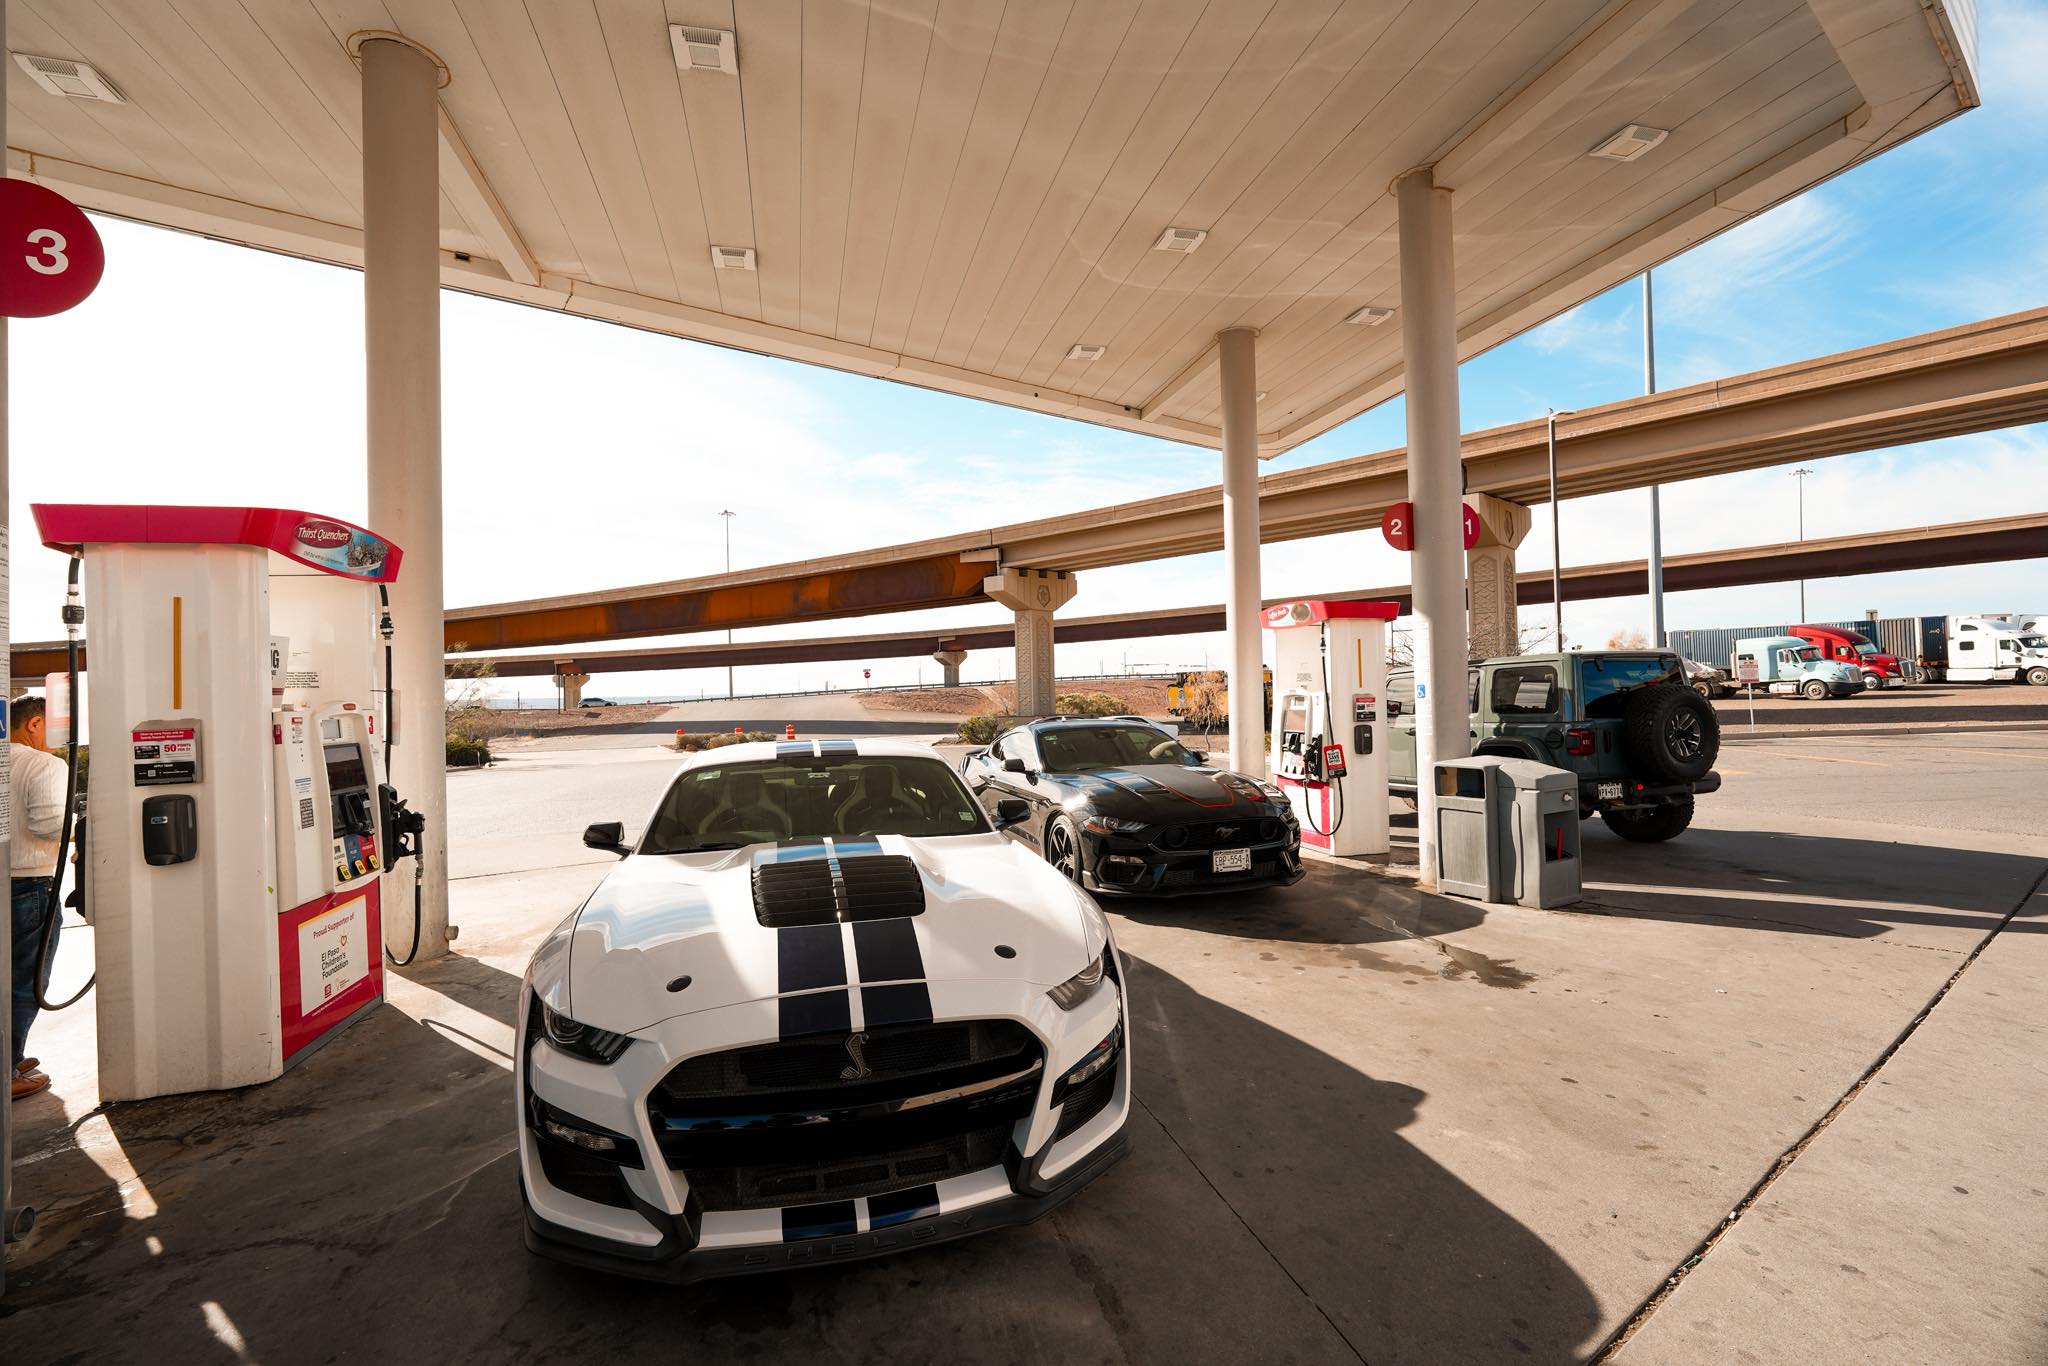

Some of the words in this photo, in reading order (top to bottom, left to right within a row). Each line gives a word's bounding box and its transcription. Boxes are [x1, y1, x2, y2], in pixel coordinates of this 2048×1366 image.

[25, 228, 69, 275] 3
[298, 527, 318, 539] Thirst
[317, 529, 350, 542] Quenchers
[1390, 518, 1403, 535] 2
[1465, 518, 1472, 535] 1
[368, 715, 374, 734] 3
[164, 744, 177, 752] 50
[313, 926, 328, 939] Proud
[327, 916, 350, 932] Supporter
[349, 912, 355, 921] of
[321, 952, 327, 962] El
[327, 947, 340, 959] Paso
[321, 952, 346, 971] Children's
[322, 960, 349, 980] Foundation
[743, 1215, 975, 1265] SHELBY
